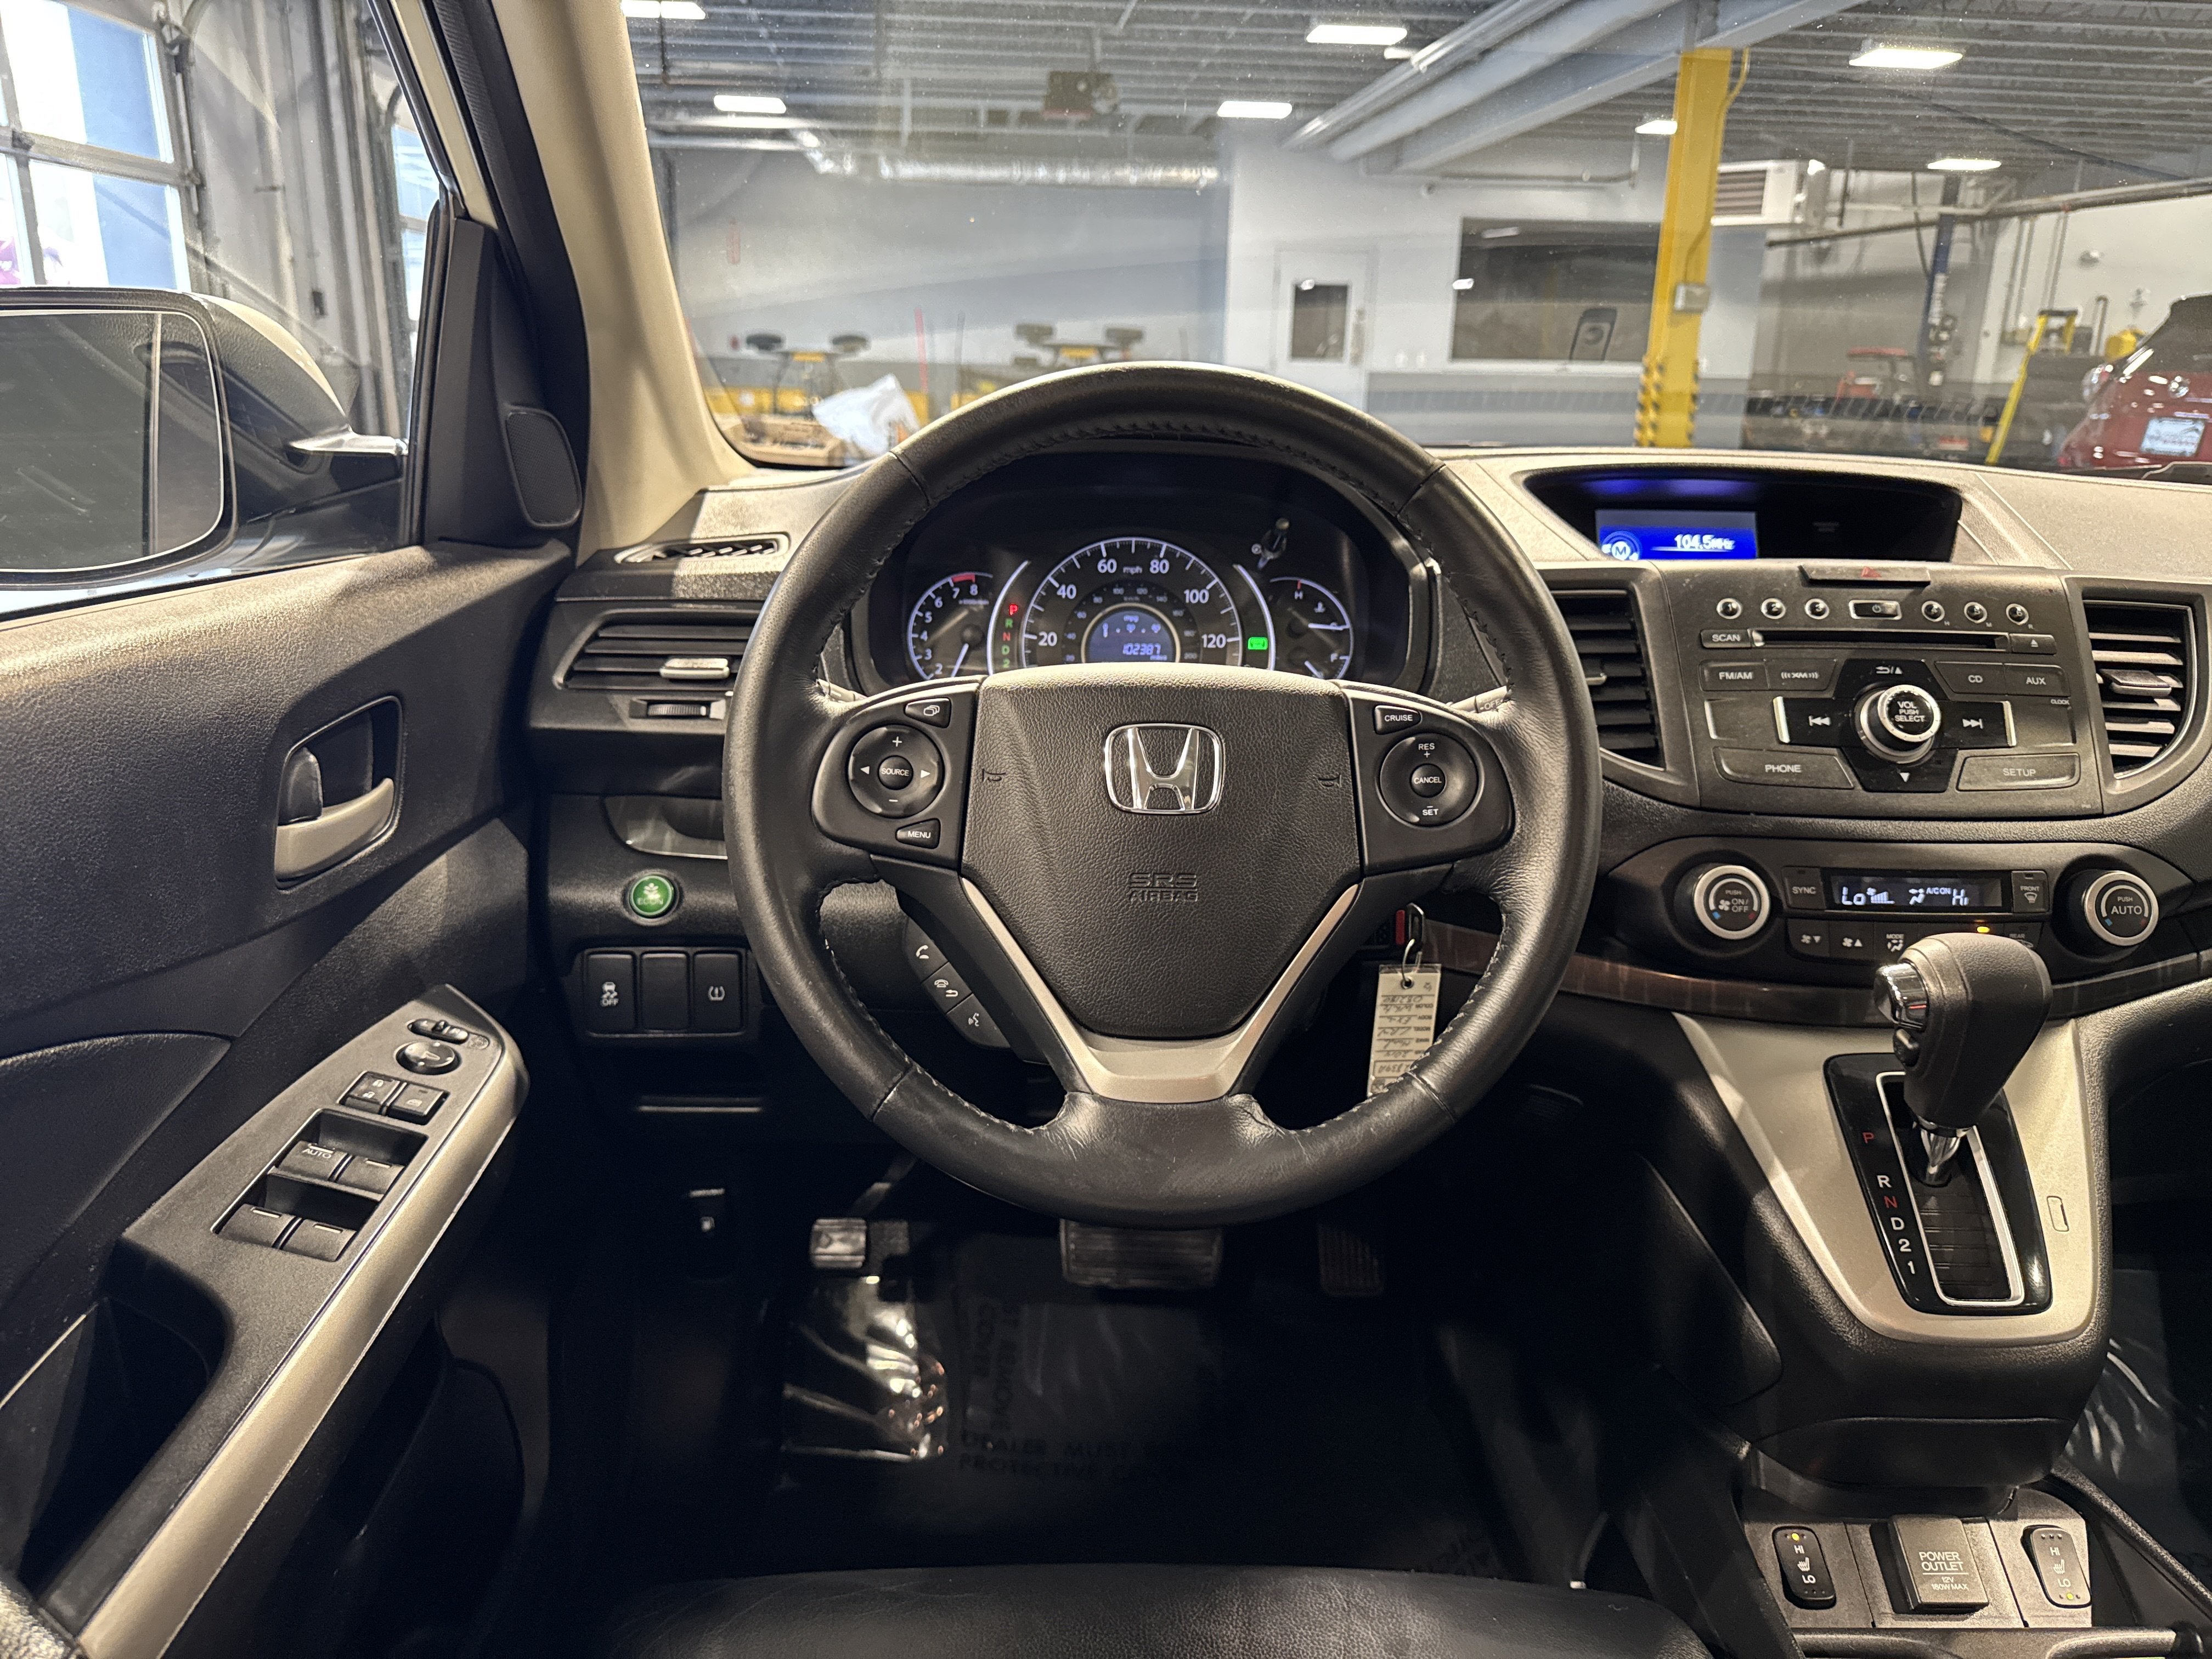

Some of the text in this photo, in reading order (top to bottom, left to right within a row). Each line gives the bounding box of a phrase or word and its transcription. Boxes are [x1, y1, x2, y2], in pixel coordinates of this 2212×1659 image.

[1098, 558, 1117, 573] 60
[1123, 566, 1143, 574] mph
[1149, 559, 1170, 574] 80
[952, 587, 960, 599] 7
[969, 584, 978, 596] 8
[1057, 584, 1077, 599] 40
[1294, 590, 1304, 600] H
[1184, 589, 1209, 603] 100
[934, 596, 943, 608] 6
[1008, 603, 1018, 616] P
[1728, 603, 1733, 612] 1
[924, 611, 932, 623] 5
[1005, 618, 1013, 628] R
[920, 630, 928, 641] 4
[1003, 632, 1011, 641] N
[1038, 631, 1057, 646] 20
[1201, 634, 1226, 648] 120
[925, 648, 932, 660] 3
[1001, 645, 1010, 655] D
[1123, 643, 1161, 655] 102387
[1003, 659, 1010, 668] 2
[934, 663, 943, 675] 2
[1968, 675, 1983, 684] CD
[2025, 677, 2046, 685] AUX
[1897, 701, 1917, 709] VOL
[881, 768, 910, 776] SOURCE
[1764, 764, 1802, 773] PHONE
[2002, 769, 2036, 777] SETUP
[907, 831, 931, 839] MENU
[1130, 873, 1197, 887] SRS
[1792, 886, 1816, 895] SYNC
[1129, 890, 1198, 902] AIRBAG
[1842, 887, 1866, 905] Lo
[637, 898, 664, 906] ECON
[2111, 905, 2142, 915] AUTO
[1862, 1132, 1875, 1144] P
[302, 1149, 332, 1159] AUTO
[1876, 1175, 1892, 1188] R
[1883, 1195, 1898, 1209] N
[1891, 1216, 1905, 1231] D
[1898, 1238, 1912, 1252] 2
[1907, 1261, 1915, 1274] 1
[1793, 1545, 1805, 1554] HI
[2049, 1547, 2061, 1556] HI
[1918, 1551, 1961, 1561] POWER
[1921, 1561, 1963, 1571] OUTLET
[1802, 1575, 1815, 1584] LO
[2057, 1579, 2071, 1588] LO
